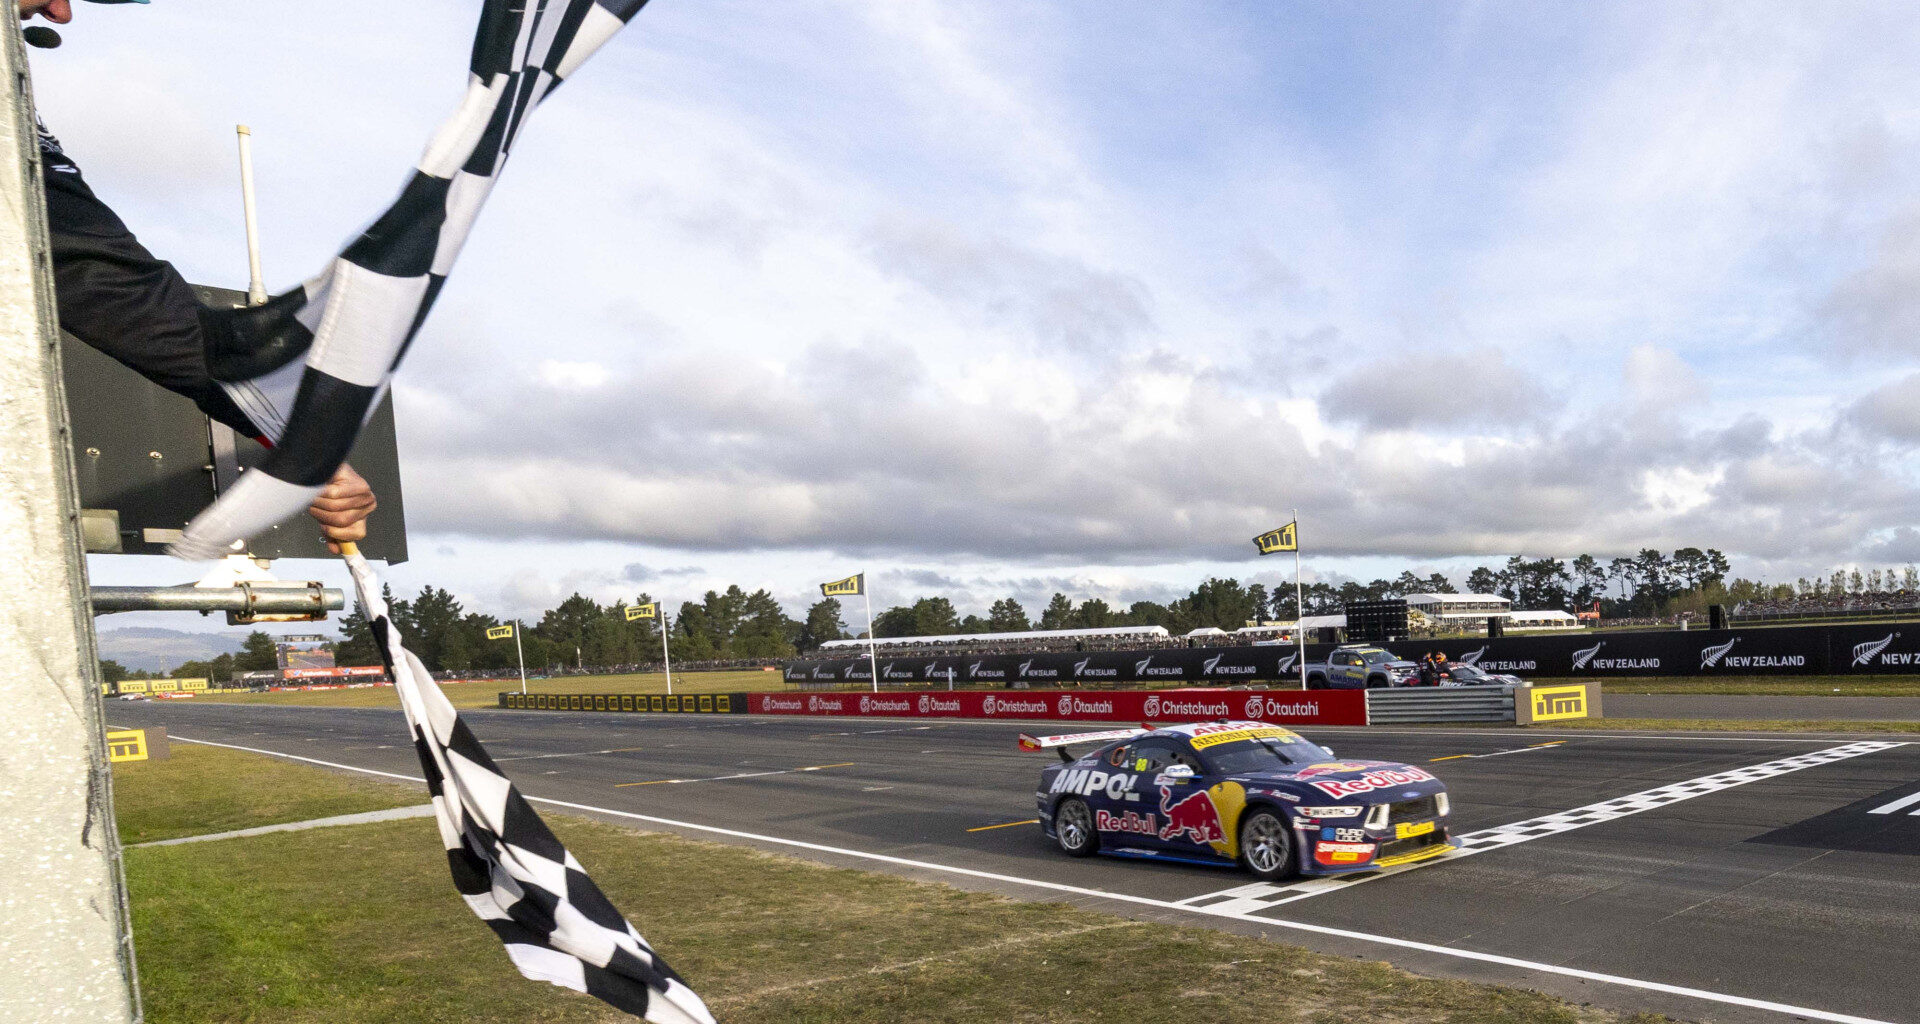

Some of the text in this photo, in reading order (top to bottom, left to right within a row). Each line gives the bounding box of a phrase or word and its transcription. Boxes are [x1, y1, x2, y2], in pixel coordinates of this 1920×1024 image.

[1593, 658, 1660, 668] NEW ZEALAND
[1726, 656, 1805, 666] NEW ZEALAND
[1882, 654, 1910, 664] NEW
[1478, 662, 1497, 670] NEW
[1498, 661, 1536, 670] ZEALAND
[771, 700, 802, 710] Christchurch
[871, 700, 910, 711] Christchurch
[997, 698, 1112, 713] Christchurch Ōtautahi
[1162, 699, 1319, 716] Christchurch Ōtautahi
